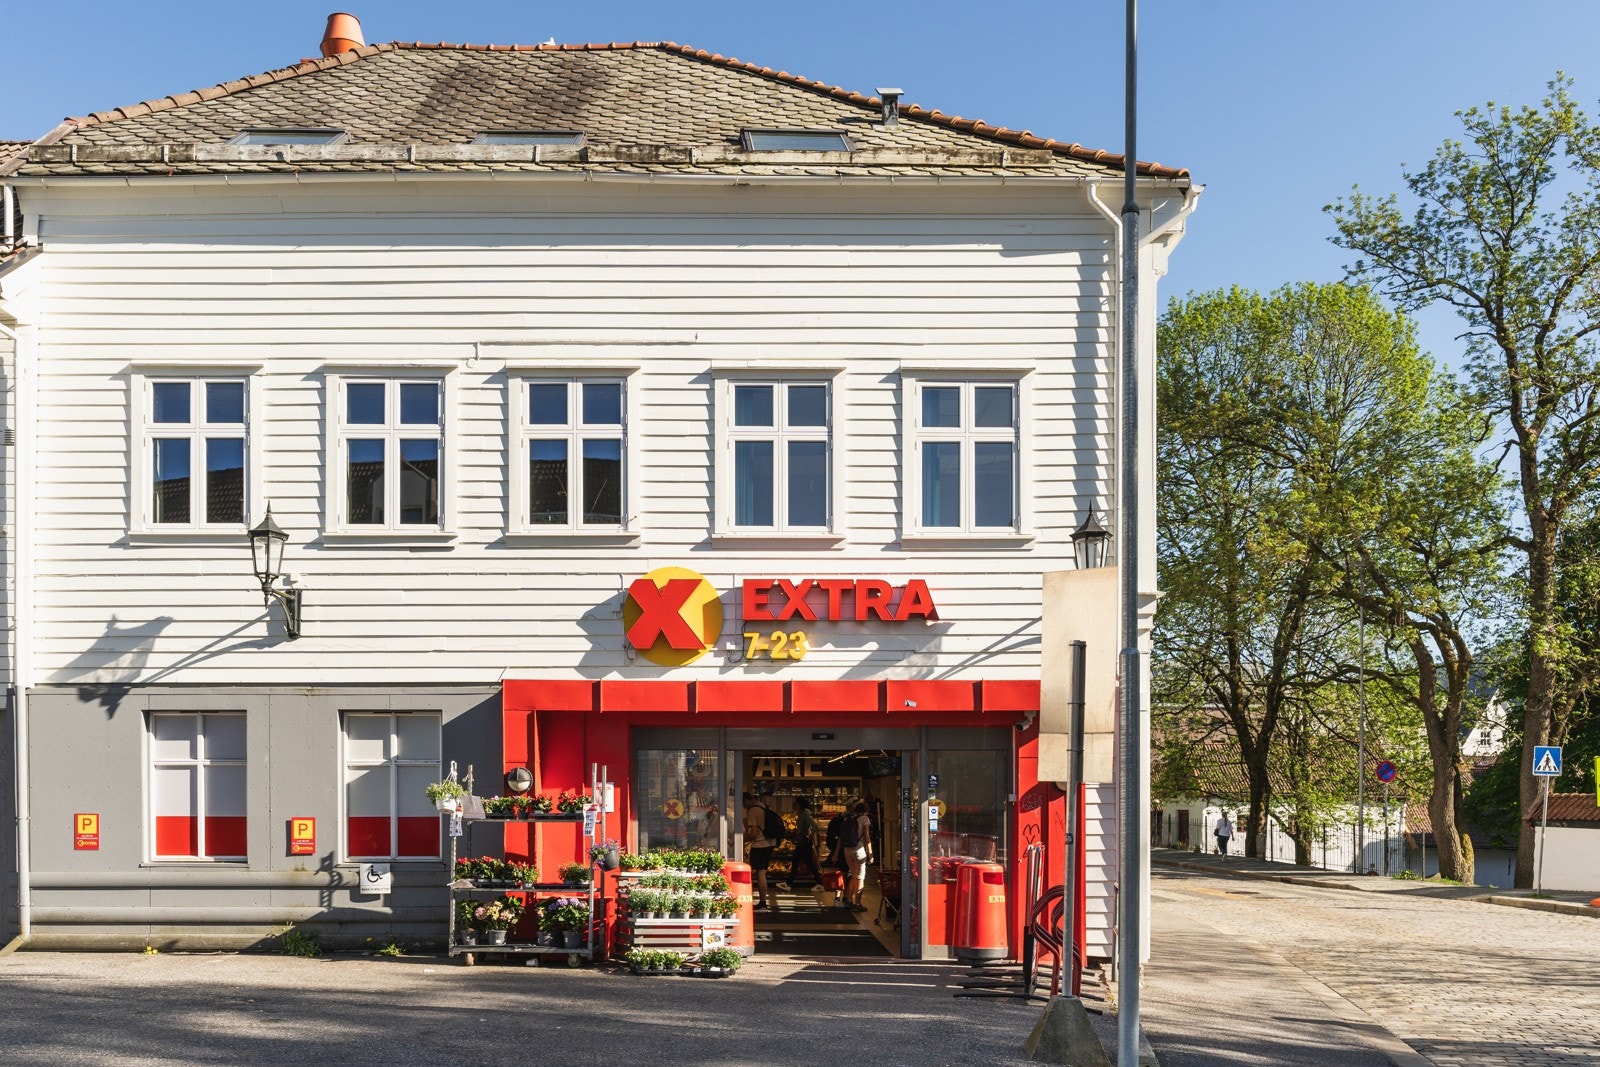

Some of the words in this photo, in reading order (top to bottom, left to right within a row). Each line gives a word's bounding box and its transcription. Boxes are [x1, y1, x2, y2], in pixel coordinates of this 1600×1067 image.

[742, 578, 940, 621] EXTRA
[743, 631, 808, 660] 7-23
[82, 817, 92, 831] P
[298, 823, 308, 836] P
